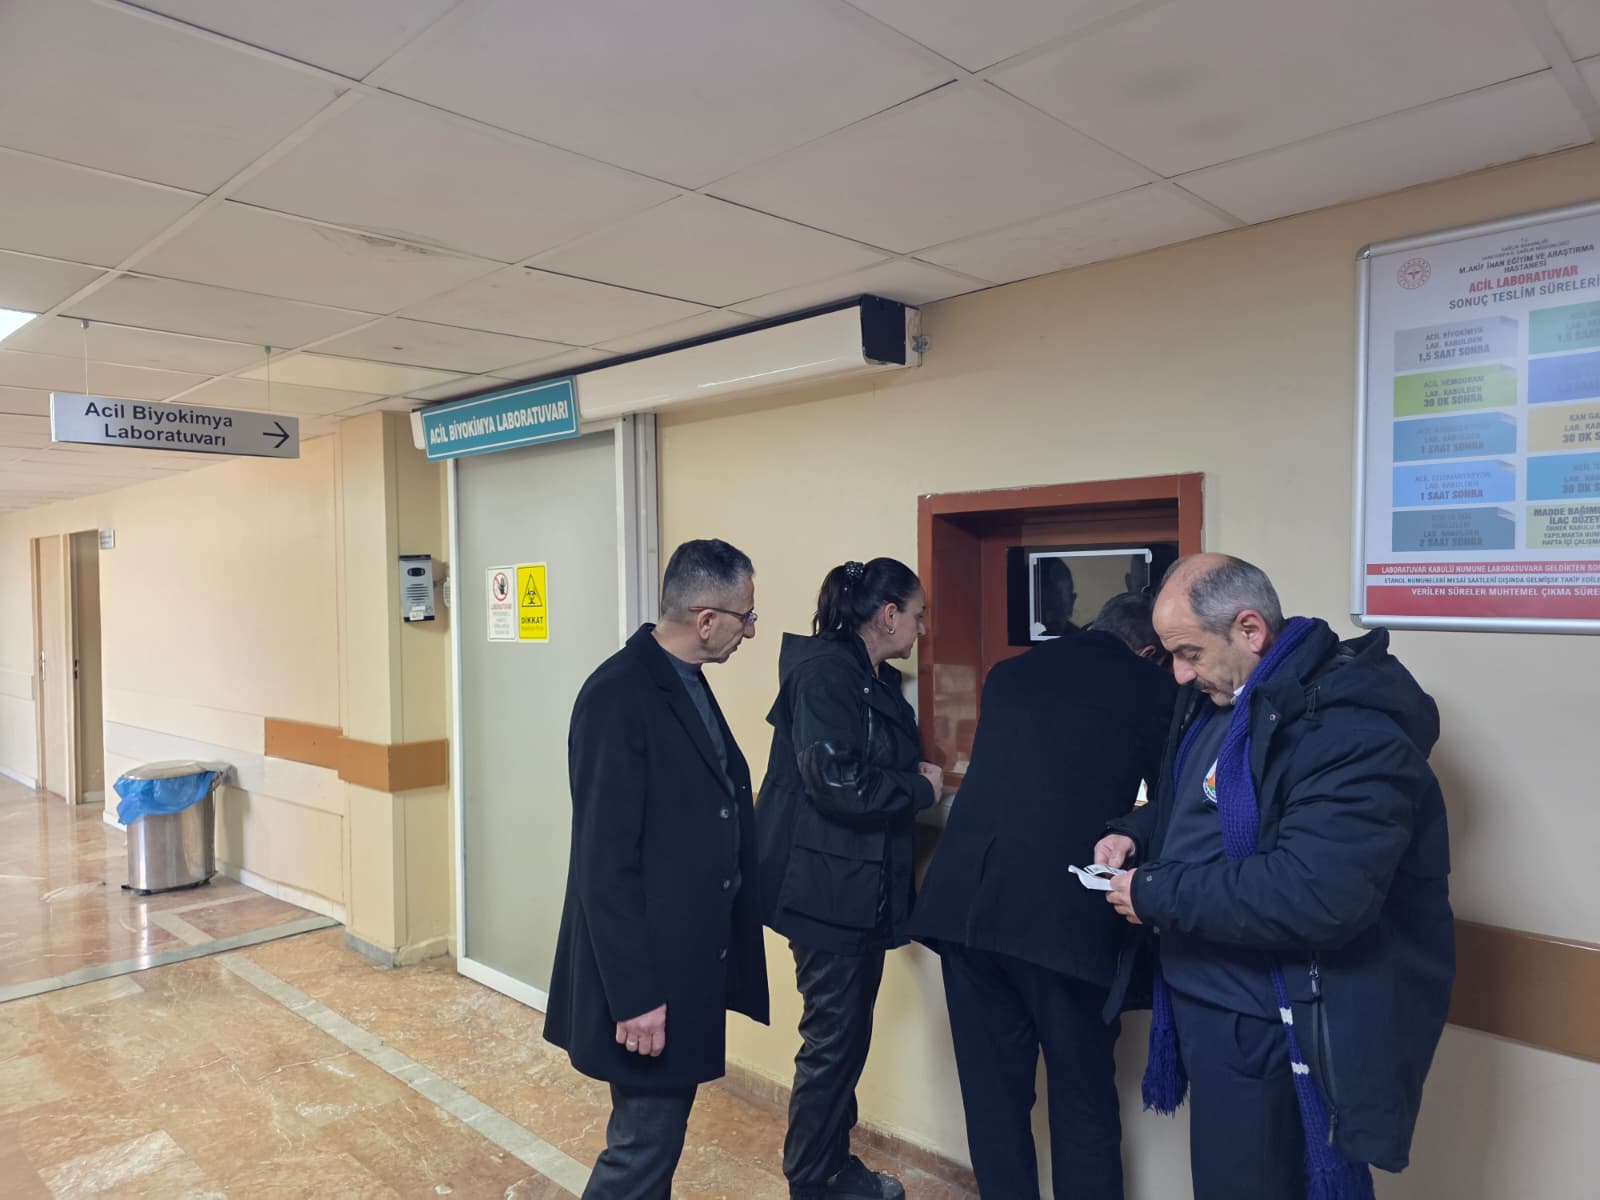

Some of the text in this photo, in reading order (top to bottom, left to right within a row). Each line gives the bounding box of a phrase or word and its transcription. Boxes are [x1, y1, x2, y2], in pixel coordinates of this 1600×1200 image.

[1469, 265, 1579, 293] ACİL LABORATUVAR
[1449, 295, 1489, 310] SONUÇ
[1492, 286, 1535, 304] TESLİM
[1418, 352, 1432, 362] 1,5
[1433, 348, 1456, 360] SAAT
[84, 401, 233, 429] Acil Biyokimya
[430, 399, 569, 445] ACİL BİYOKİMYA LABORATUVARI
[104, 423, 227, 447] Laboratuvarı
[1427, 490, 1450, 501] SAAT
[1451, 488, 1484, 500] SONRA
[1533, 507, 1566, 517] MADDE
[1381, 566, 1427, 574] LABORATUVAR
[1456, 565, 1487, 573] NUMUNE
[1488, 564, 1543, 573] LABORATUVARA
[1411, 587, 1446, 596] VERİLEN
[1447, 586, 1487, 596] SÜRELER
[1488, 587, 1538, 596] MUHTEMEL
[1540, 587, 1572, 598] ÇIKMA
